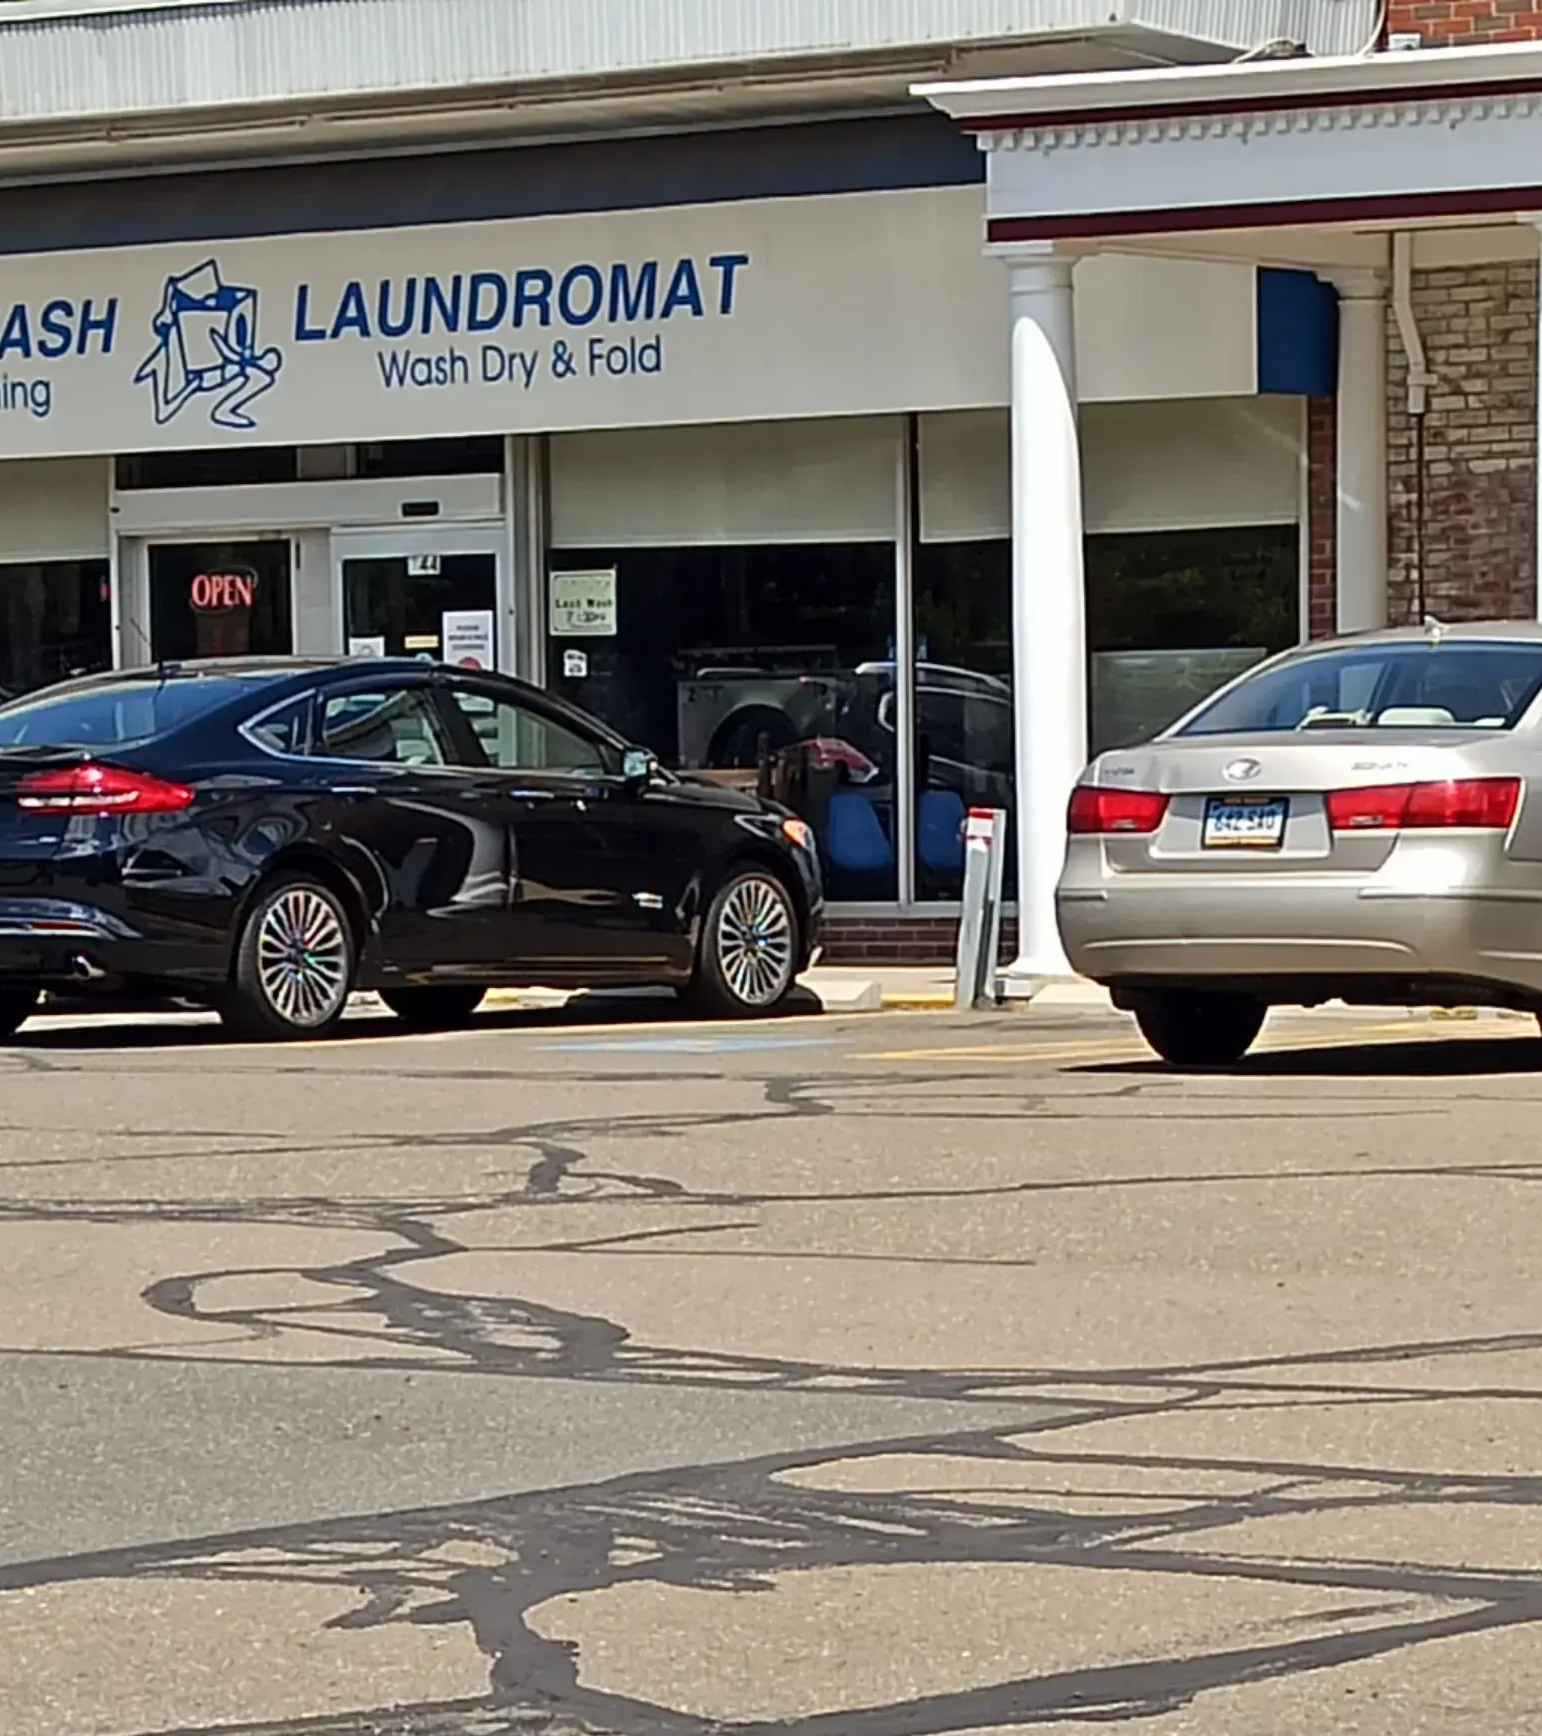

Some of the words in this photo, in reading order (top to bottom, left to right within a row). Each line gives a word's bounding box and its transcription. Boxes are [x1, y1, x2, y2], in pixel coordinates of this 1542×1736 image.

[294, 255, 749, 341] LAUNDROMAT
[377, 347, 469, 388] Wash
[482, 344, 540, 388] Dry
[552, 339, 577, 378] &
[589, 335, 663, 376] Fold
[191, 574, 252, 606] OPEN
